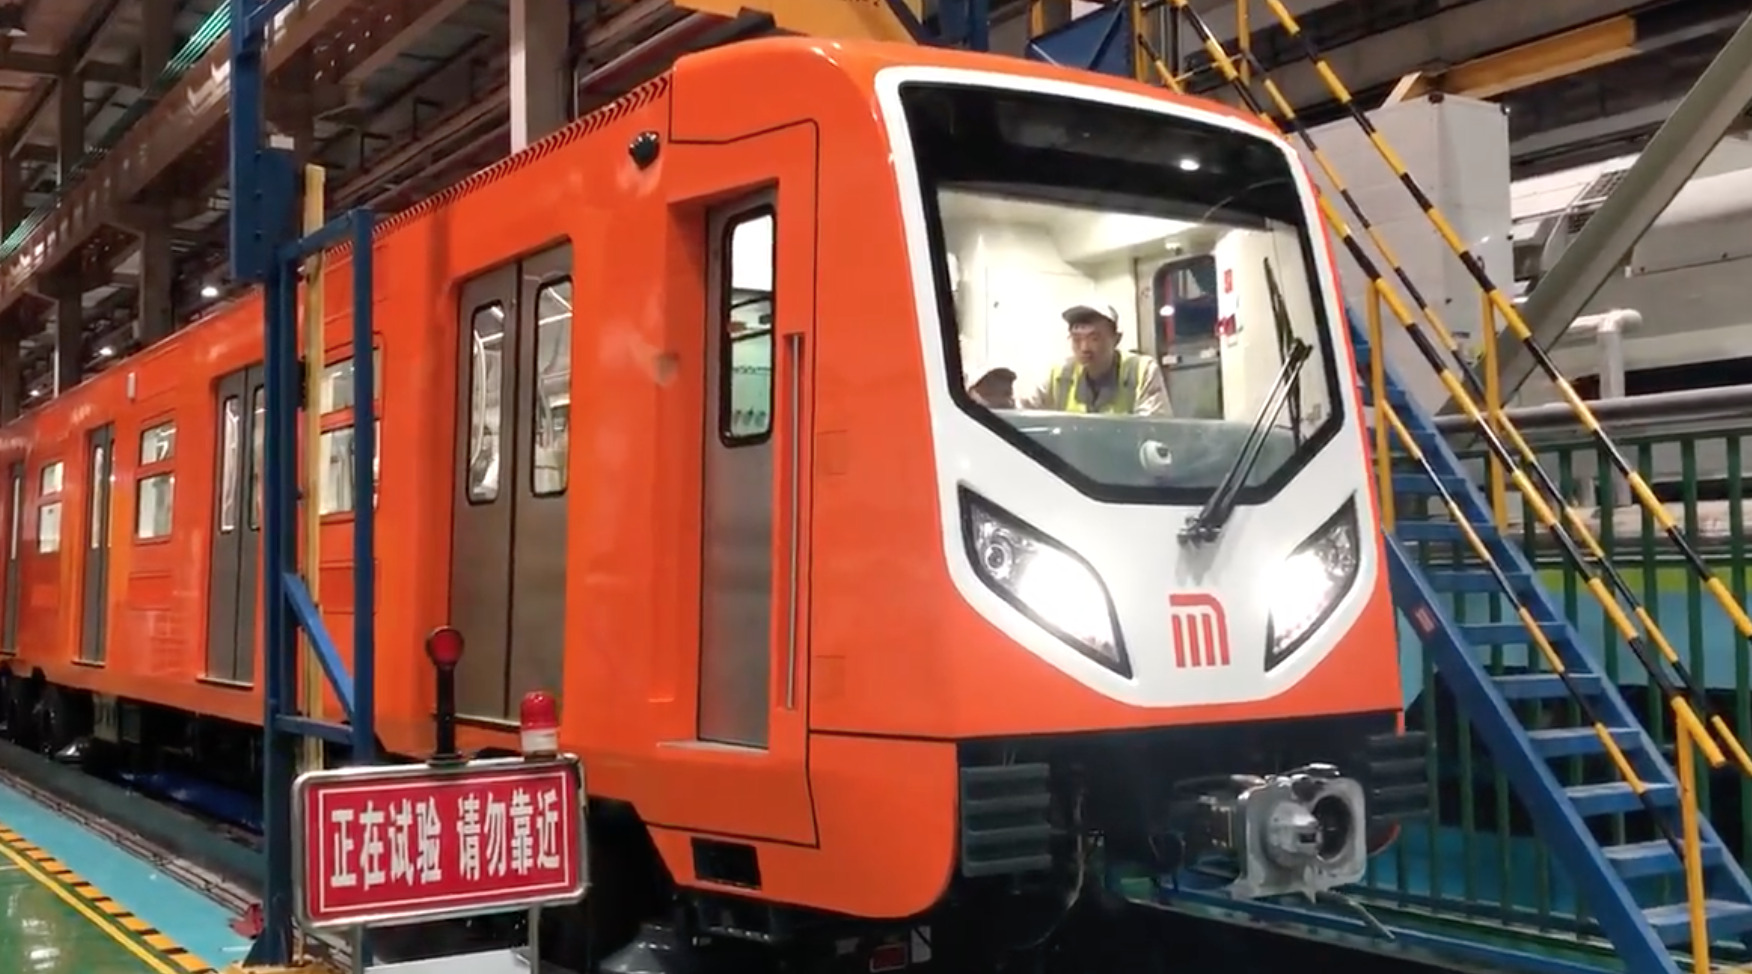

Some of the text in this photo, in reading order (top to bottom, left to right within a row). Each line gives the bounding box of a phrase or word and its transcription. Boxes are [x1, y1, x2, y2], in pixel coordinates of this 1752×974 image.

[330, 787, 560, 891] 正在试验 请勿靠近
